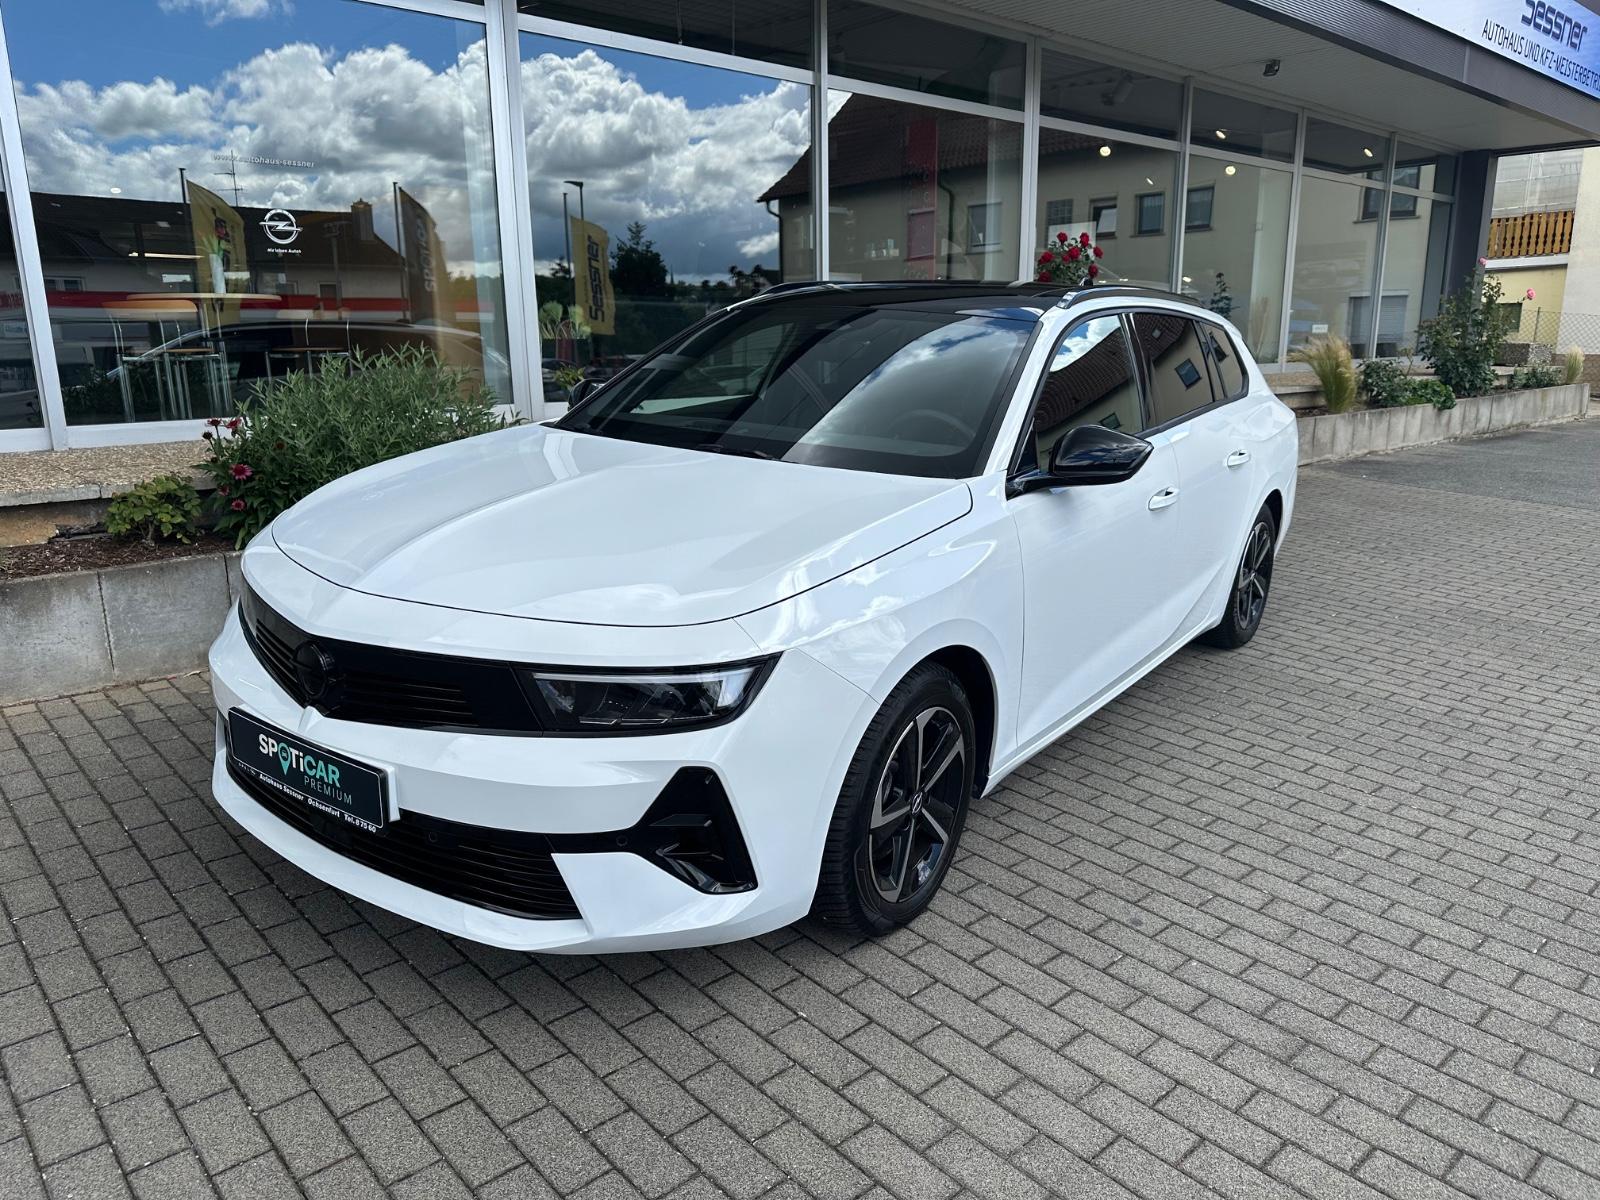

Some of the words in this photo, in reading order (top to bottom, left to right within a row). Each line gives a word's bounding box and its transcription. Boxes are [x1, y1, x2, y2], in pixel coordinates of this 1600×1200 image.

[1481, 19, 1525, 56] AUTOHAUS
[1524, 38, 1541, 63] UND
[1539, 46, 1600, 92] KFZ-MEISTERBETRI
[259, 773, 283, 790] Autohaus
[283, 785, 304, 801] Sessner
[307, 798, 340, 818] Ochsenfurt
[344, 813, 356, 825] Tel.
[304, 775, 352, 805] PREMIUM
